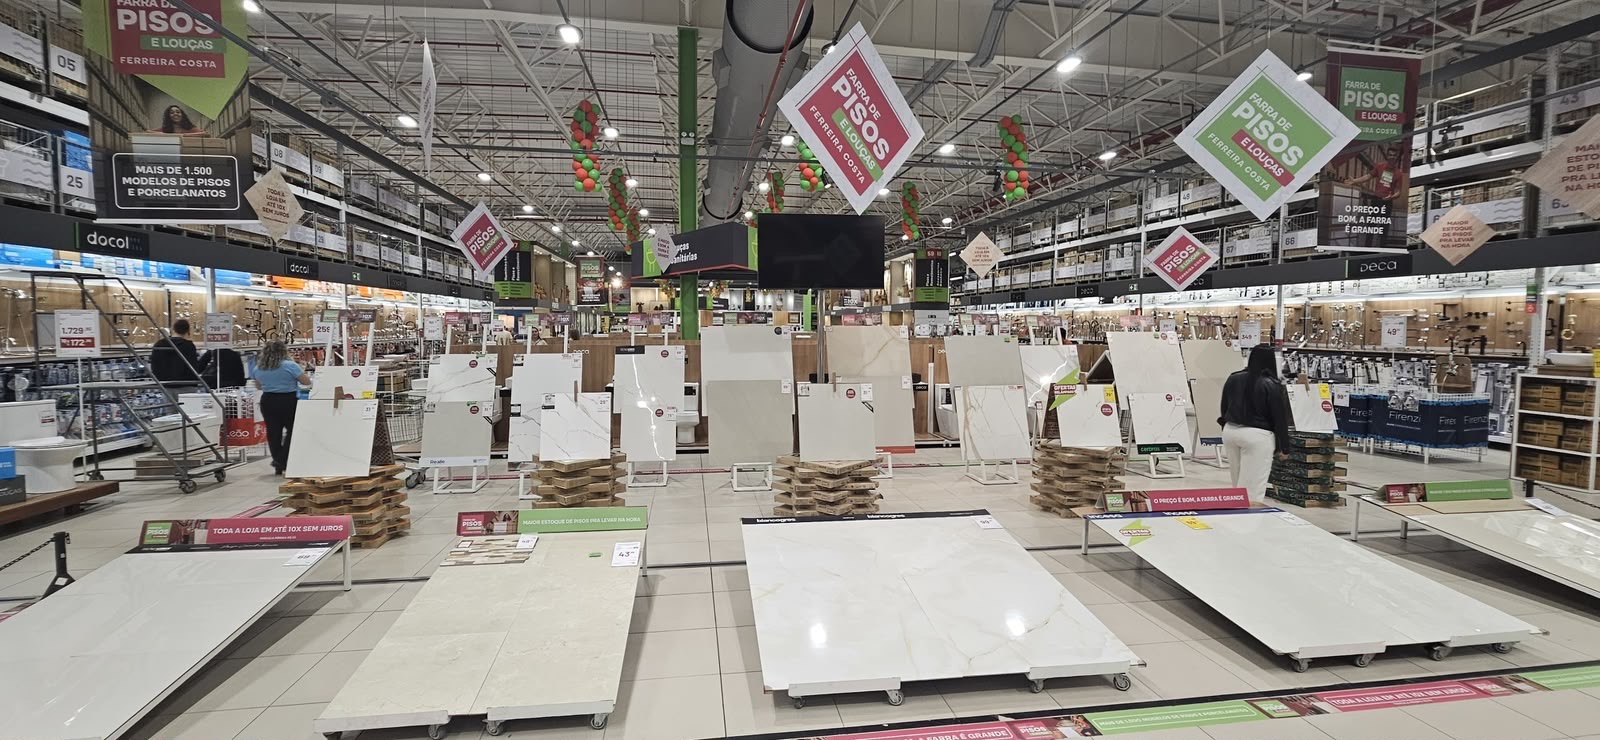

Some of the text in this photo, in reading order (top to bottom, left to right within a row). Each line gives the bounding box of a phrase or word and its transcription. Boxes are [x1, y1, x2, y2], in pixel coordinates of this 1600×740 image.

[117, 9, 214, 35] PISOS
[151, 37, 214, 51] E LOUÇAS
[57, 57, 76, 73] 05
[120, 56, 217, 69] FERREIRA COSTA
[1344, 80, 1381, 91] FARRA DE
[846, 68, 881, 120] FARRA DE
[1343, 90, 1400, 110] PISOS
[832, 75, 890, 160] PISOS
[1249, 92, 1293, 132] FARRA DE
[1361, 111, 1398, 122] E LOUÇAS
[1231, 101, 1304, 167] PISOS
[1376, 127, 1398, 136] COSTA
[809, 105, 865, 184] FERREIRA COSTA
[840, 119, 876, 170] E LOUÇAS
[274, 148, 283, 159] 08
[1240, 136, 1284, 177] E LOUÇAS
[1207, 132, 1271, 191] FERREIRA COSTA
[136, 165, 212, 176] MAIS DE 1.500
[1567, 164, 1584, 173] DE
[66, 174, 83, 189] 25
[122, 176, 231, 188] MODELOS DE PISOS
[1561, 174, 1587, 183] PRA
[128, 187, 227, 199] E PORCELANATOS
[1565, 183, 1584, 192] NA
[1344, 204, 1386, 215] O PREÇO É
[1338, 215, 1392, 225] BOM, A FARRA
[1344, 224, 1384, 235] É GRANDE
[86, 231, 129, 249] docol
[469, 226, 496, 255] PISOS
[1285, 236, 1295, 246] 66
[1163, 244, 1196, 273] PISOS
[290, 263, 310, 275] docol
[61, 327, 84, 335] 1.729
[1389, 411, 1422, 423] Firenzi
[273, 525, 287, 533] ATÉ
[967, 730, 1009, 739] GRANDE
